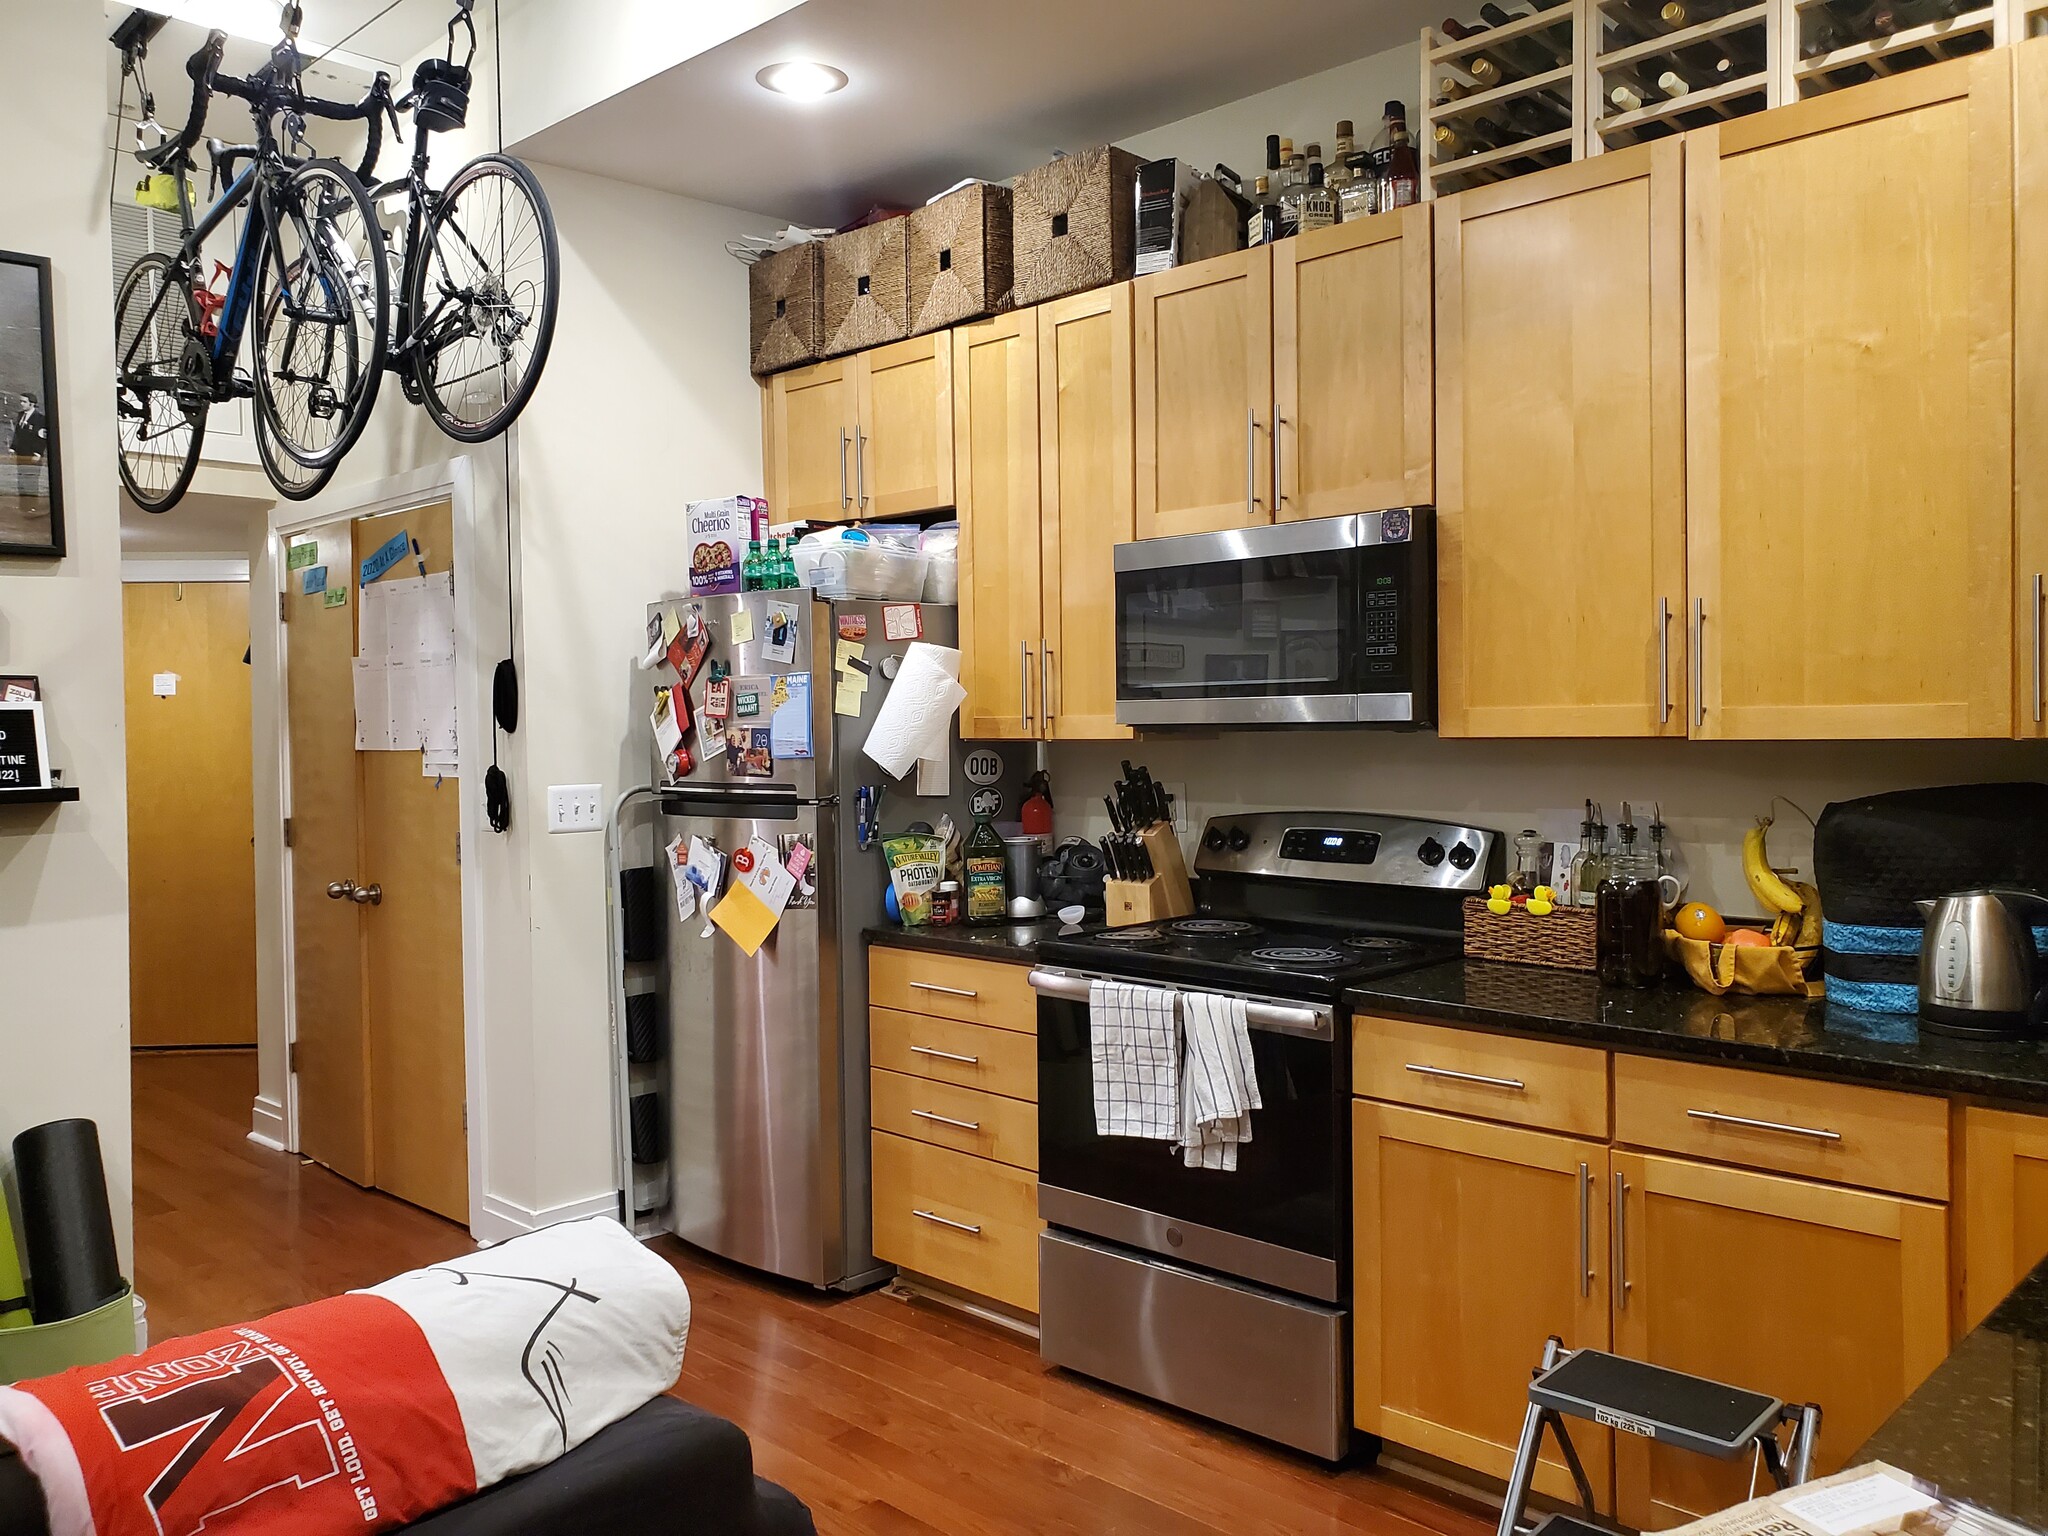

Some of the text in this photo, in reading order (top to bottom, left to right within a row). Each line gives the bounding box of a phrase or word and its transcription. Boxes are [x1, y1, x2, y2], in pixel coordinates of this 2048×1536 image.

[1306, 201, 1331, 213] KNOB
[692, 518, 731, 534] Cheerios
[692, 576, 709, 586] 100%
[787, 675, 808, 685] MAINE
[711, 683, 727, 695] EAT
[738, 695, 756, 704] WICKED
[737, 703, 758, 714] SMAAHT
[735, 853, 750, 867] B
[971, 863, 1001, 872] POMPEIAN
[900, 865, 939, 882] PROTEIN
[84, 1341, 268, 1407] ZONE
[284, 1352, 328, 1398] ROWDY.
[318, 1399, 345, 1432] GET
[1597, 1414, 1609, 1423] 102
[1610, 1418, 1619, 1428] kg
[1620, 1421, 1636, 1432] (225
[1636, 1427, 1652, 1437] lbs.)
[337, 1431, 366, 1485] LOUD.
[354, 1486, 378, 1522] GET
